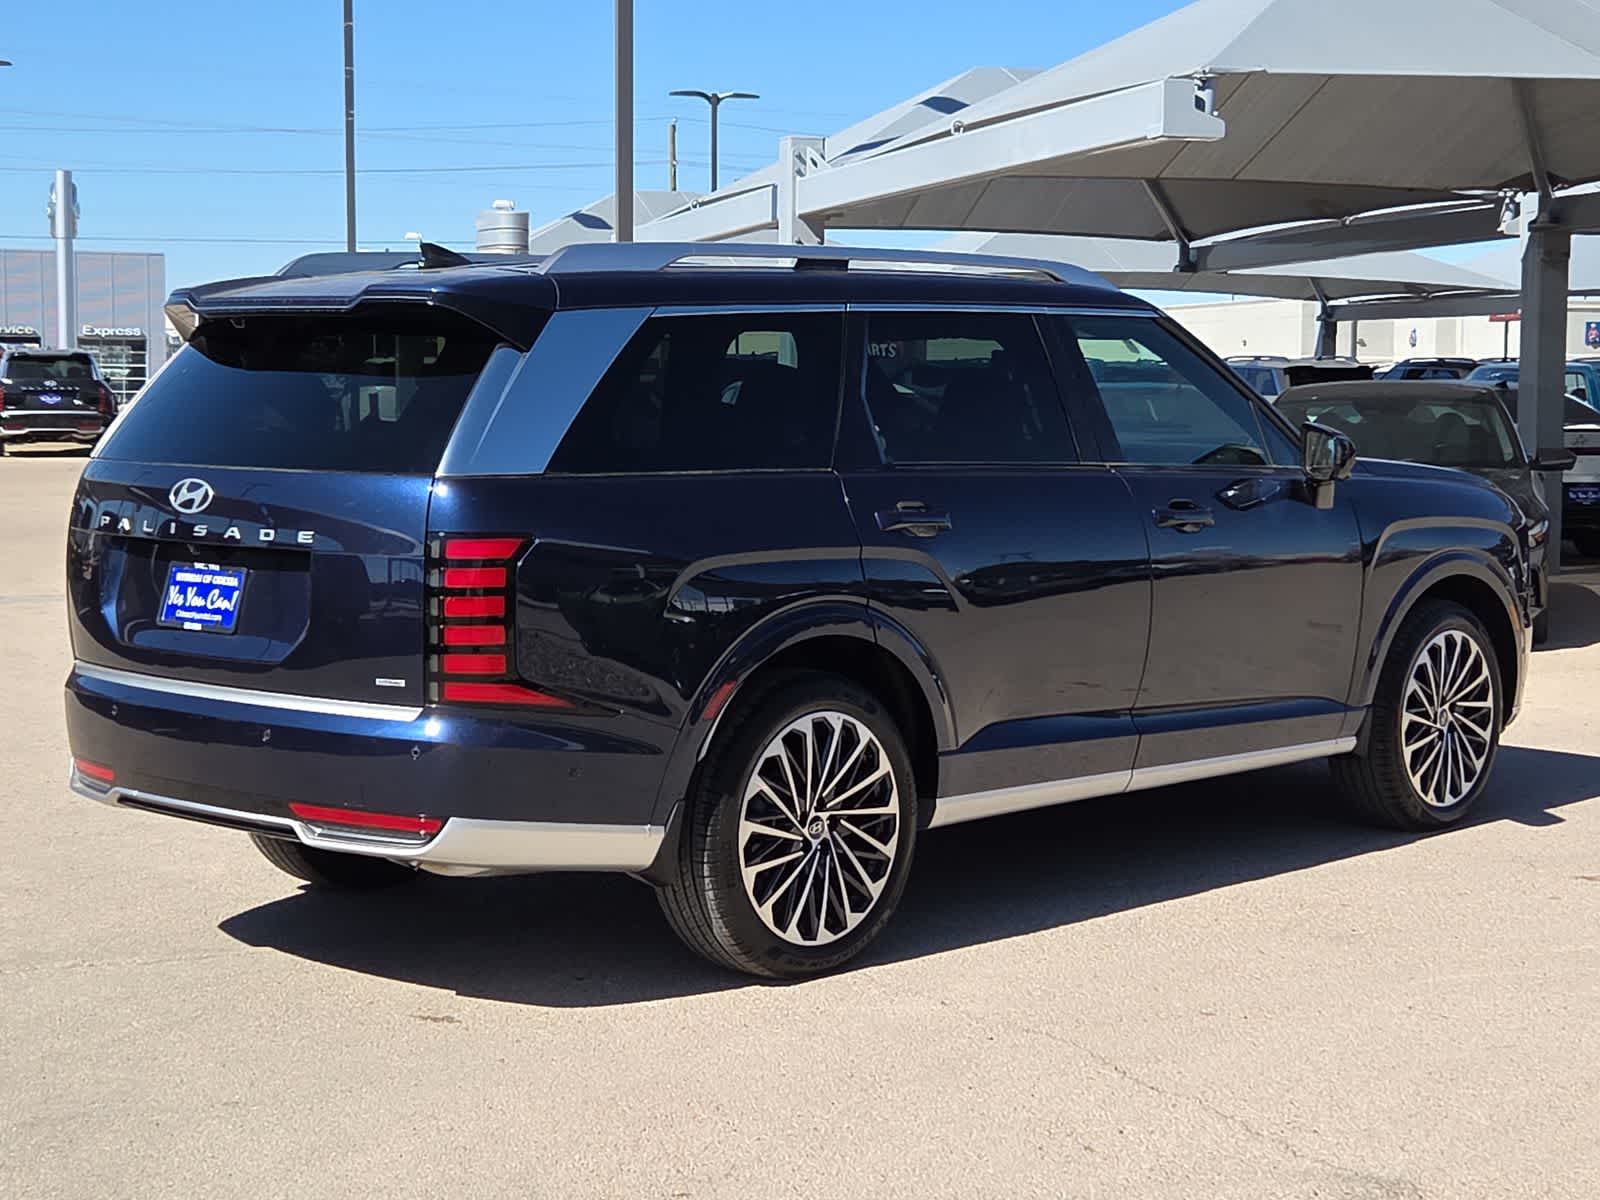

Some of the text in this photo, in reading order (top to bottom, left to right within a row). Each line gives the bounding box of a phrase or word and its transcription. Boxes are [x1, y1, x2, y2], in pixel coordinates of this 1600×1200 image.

[82, 324, 141, 338] Express
[867, 343, 897, 358] RTS
[100, 514, 315, 544] PALISADE
[168, 585, 240, 612] Yes You Can!
